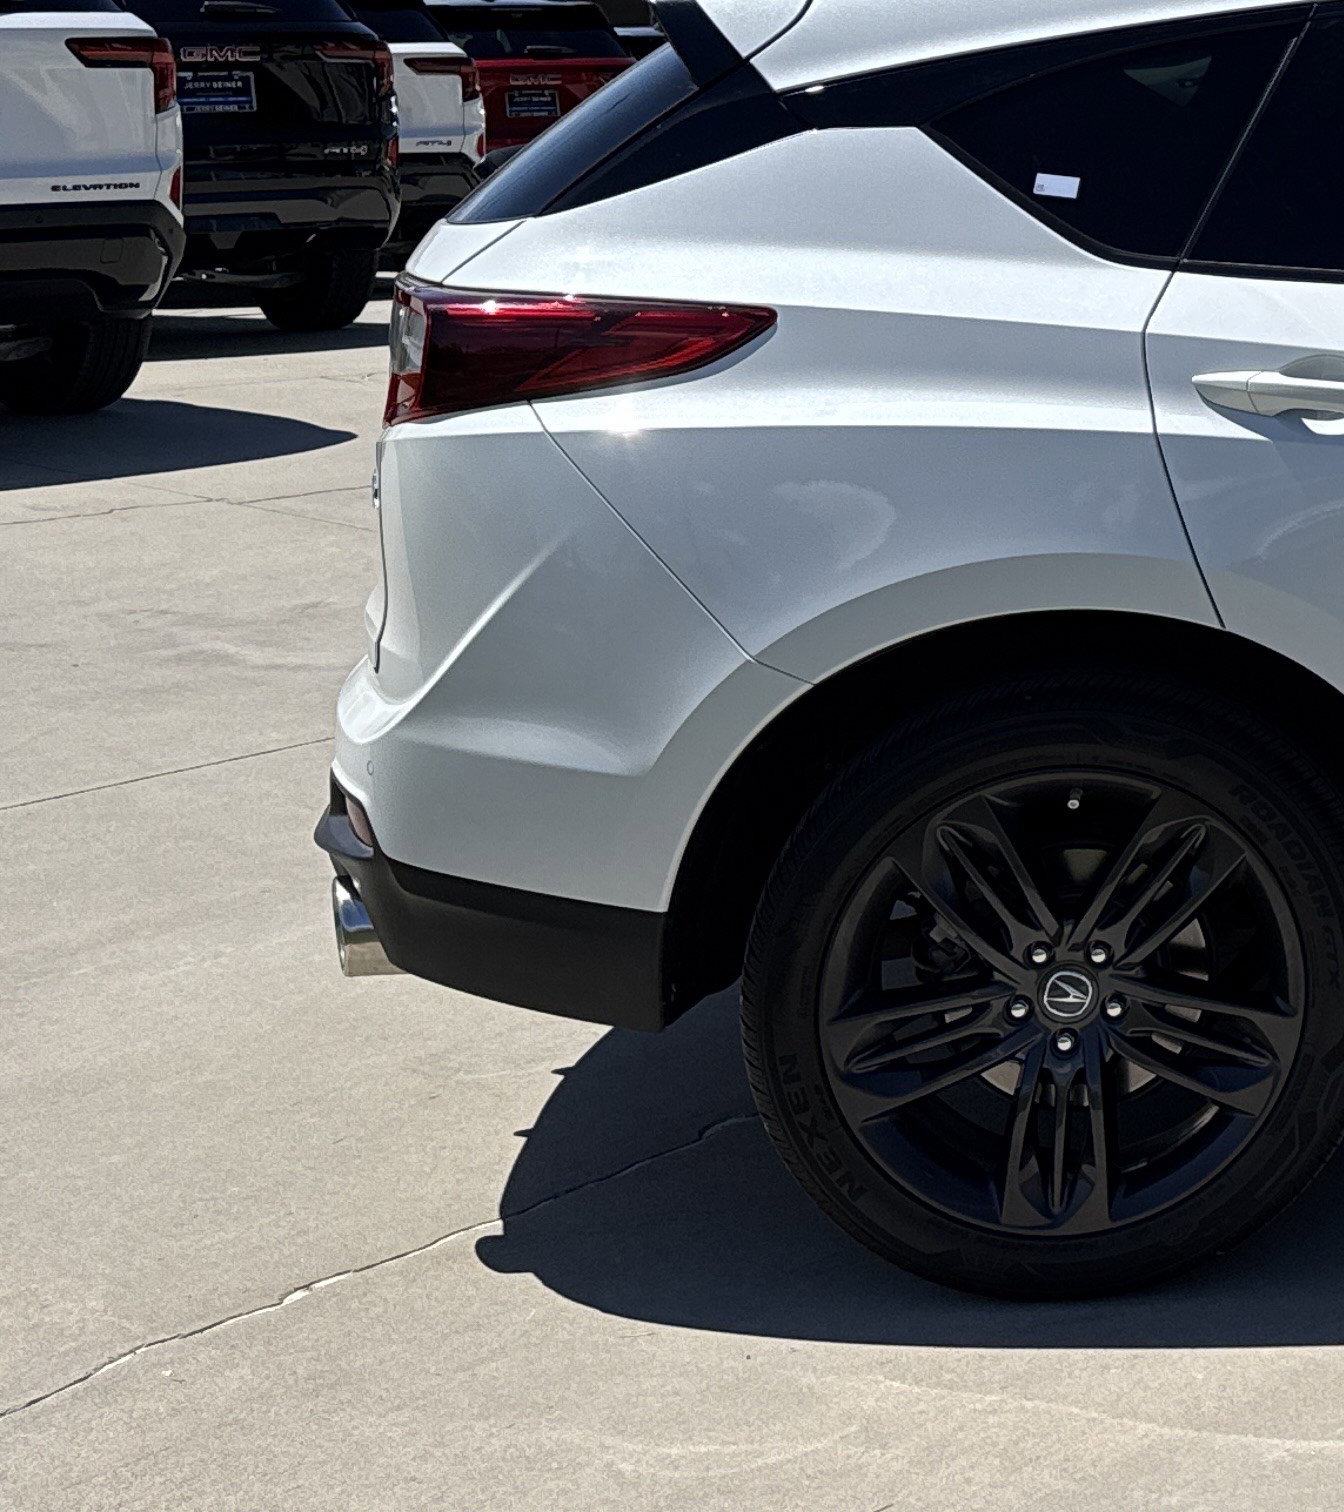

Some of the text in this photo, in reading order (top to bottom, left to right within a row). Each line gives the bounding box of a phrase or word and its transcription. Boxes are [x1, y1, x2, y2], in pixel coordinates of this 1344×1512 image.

[180, 46, 261, 61] GMC
[51, 182, 141, 192] ELEVATION
[1226, 781, 1336, 920] ROADIAN
[776, 1053, 868, 1202] NEXEN
